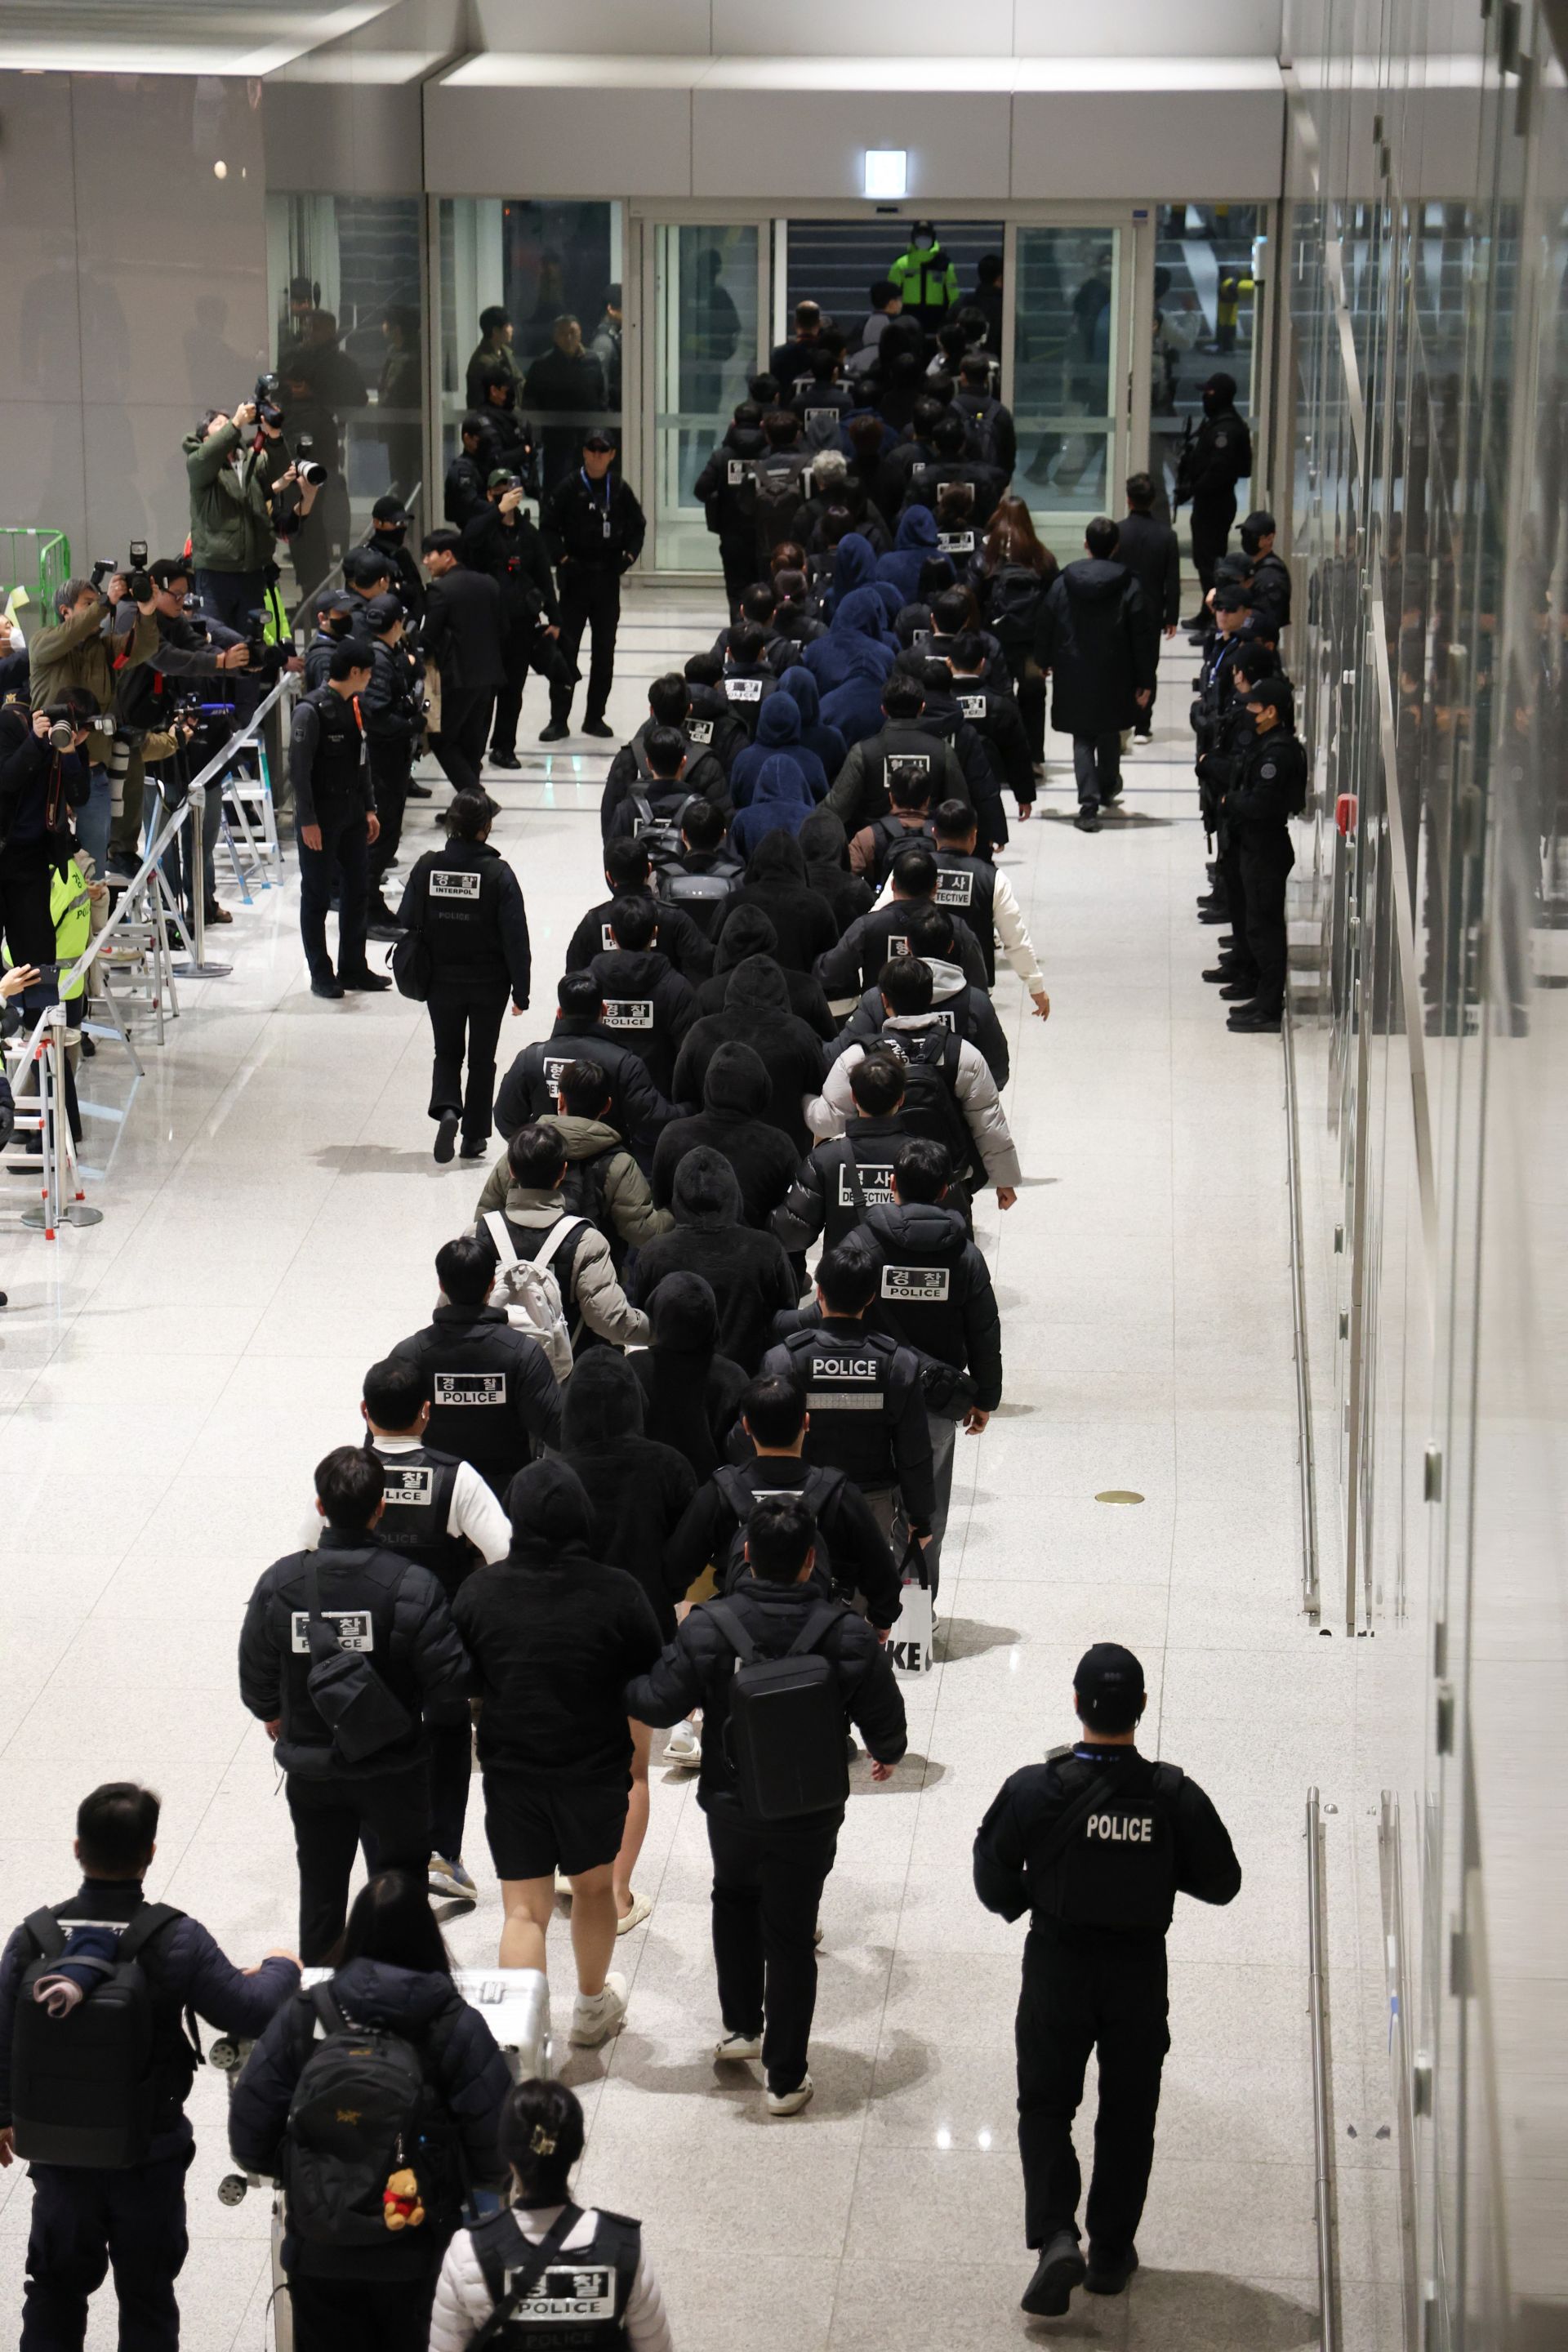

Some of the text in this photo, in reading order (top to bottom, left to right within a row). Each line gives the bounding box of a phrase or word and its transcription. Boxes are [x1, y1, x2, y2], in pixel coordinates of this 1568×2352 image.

[436, 875, 476, 889] 경찰
[436, 887, 474, 895] INTERPOL
[936, 892, 969, 903] TECTIVE
[843, 1192, 895, 1202] DEECTIVE
[892, 1271, 942, 1287] 경찰
[890, 1288, 941, 1298] POLICE
[813, 1359, 877, 1376] POLICE
[442, 1378, 497, 1391] 경찰
[443, 1392, 497, 1403] POLICE
[403, 1472, 423, 1489] 찰
[385, 1490, 421, 1501] LICE
[380, 1534, 418, 1544] OLICE
[888, 1640, 920, 1672] KE
[1086, 1814, 1153, 1842] POLICE
[518, 2301, 601, 2314] POLICE
